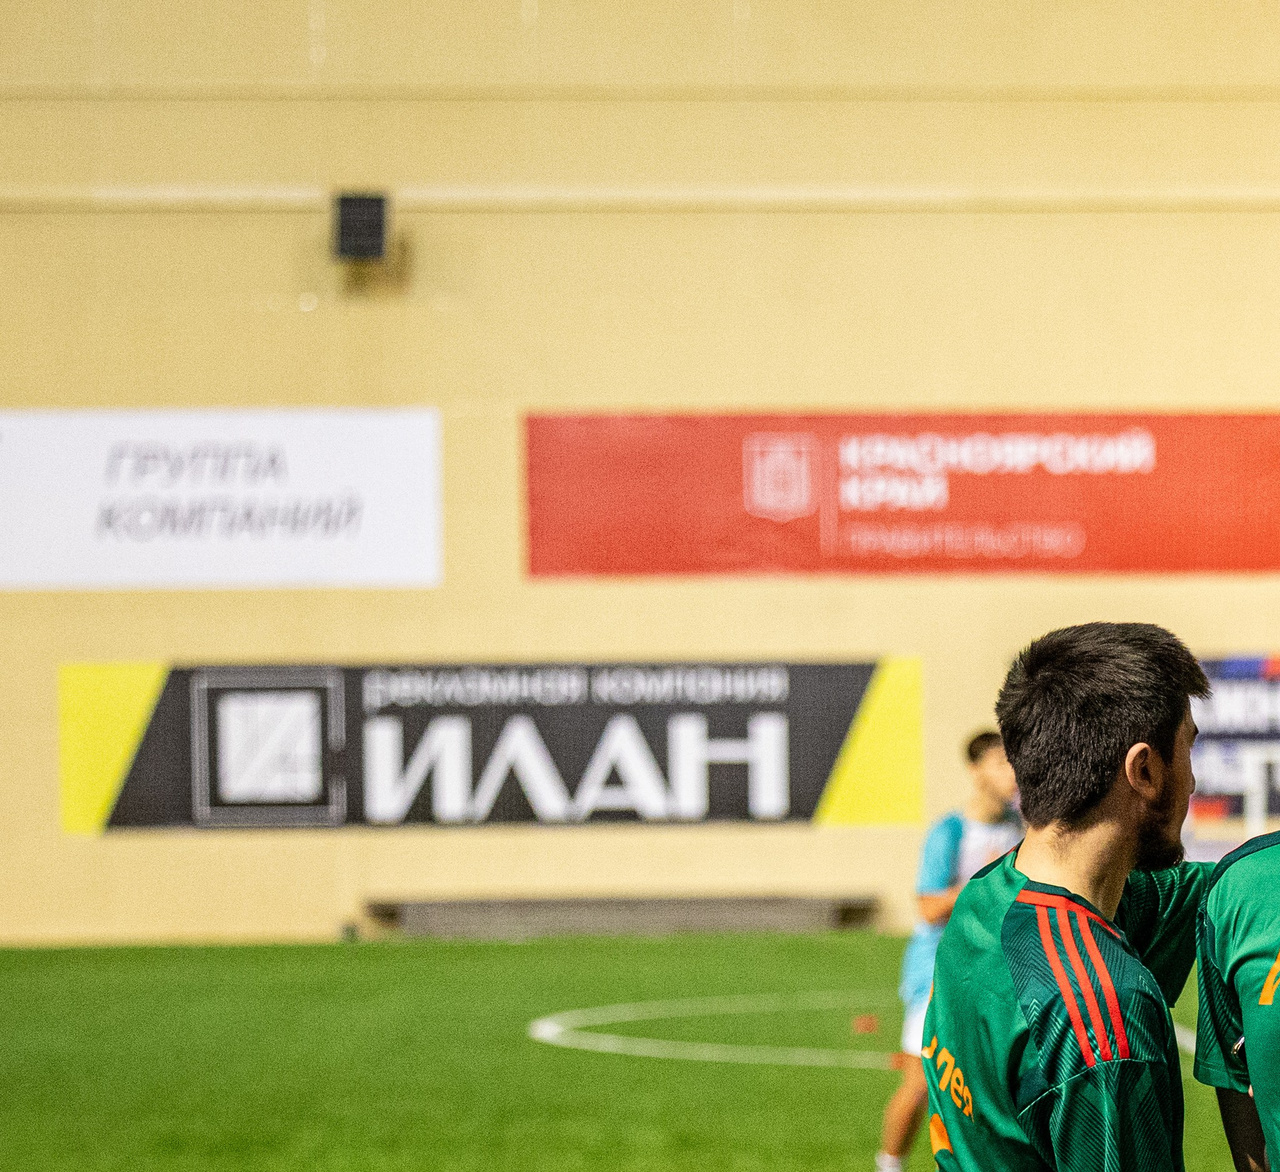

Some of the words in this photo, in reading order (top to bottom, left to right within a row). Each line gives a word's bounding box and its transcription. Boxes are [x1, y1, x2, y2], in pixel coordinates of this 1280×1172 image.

[105, 442, 287, 484] ГРУППА
[840, 430, 1157, 473] КРАСНОЯРСКИЙ
[840, 474, 949, 510] КРАЙ
[97, 490, 363, 541] КОМПАНИЙ
[363, 668, 586, 712] рекламная
[592, 668, 789, 703] компания
[363, 713, 789, 823] ИЛАН
